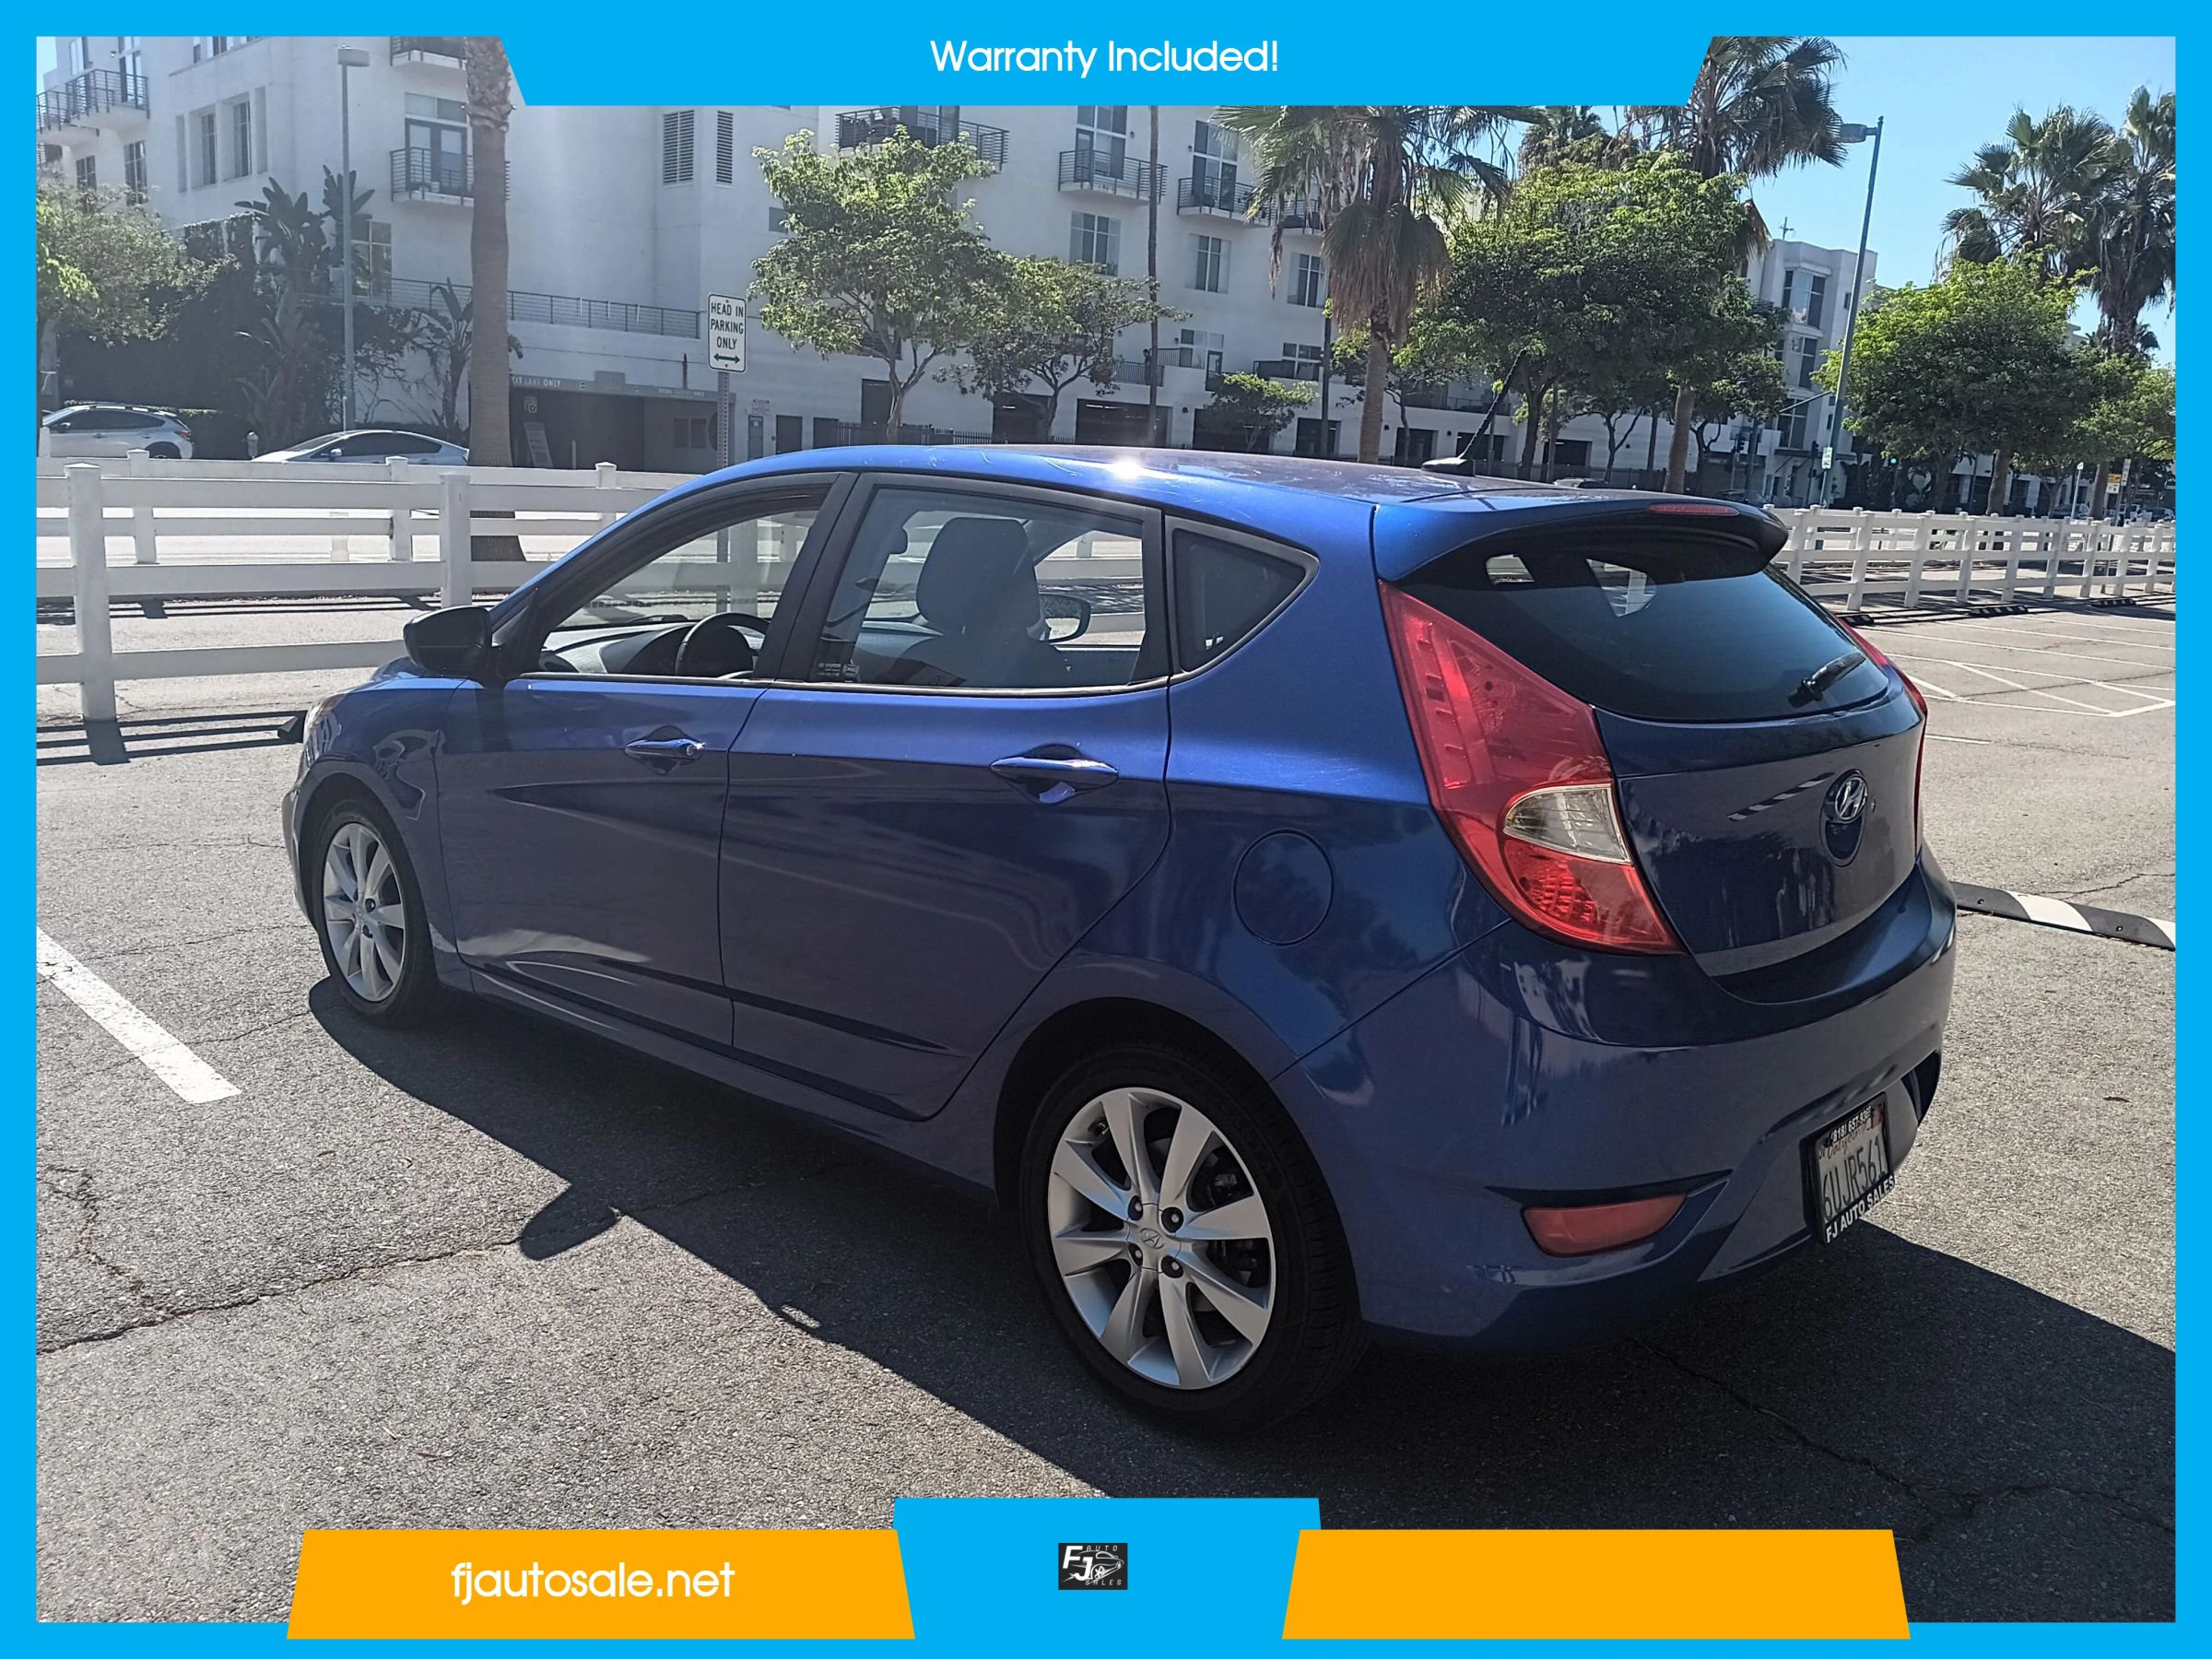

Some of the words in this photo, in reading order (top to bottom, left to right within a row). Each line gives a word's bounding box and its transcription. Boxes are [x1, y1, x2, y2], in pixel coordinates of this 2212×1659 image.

[711, 301, 732, 316] HEAD
[735, 305, 744, 318] IN
[710, 318, 744, 335] PARKING
[716, 335, 737, 350] ONLY
[1822, 1135, 1887, 1219] 6UJR561
[1825, 1220, 1839, 1244] FJ
[1840, 1199, 1865, 1232] AUTO
[1866, 1175, 1896, 1209] SALES
